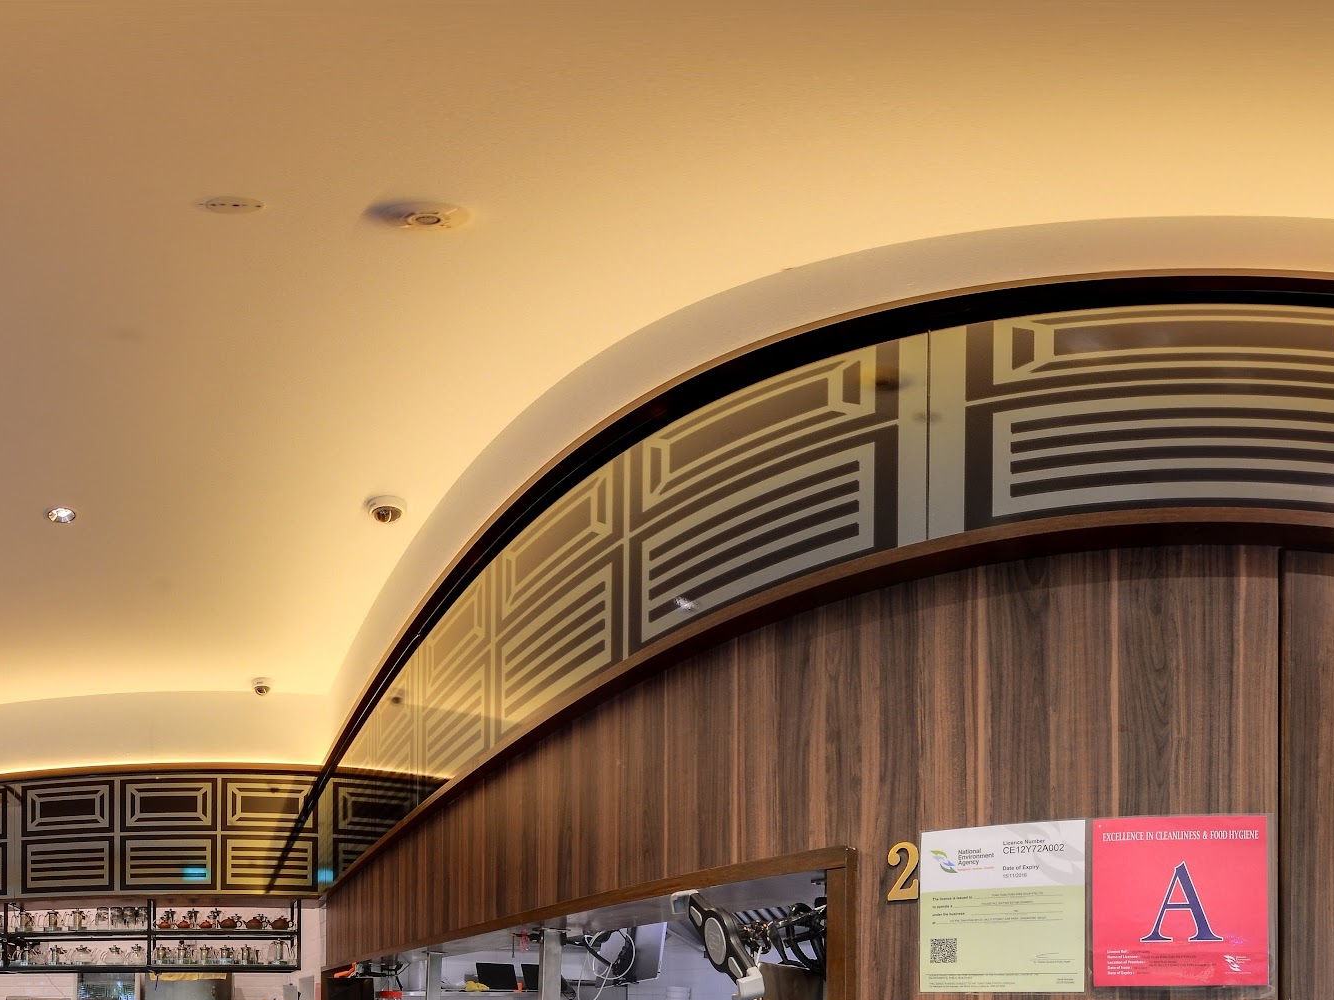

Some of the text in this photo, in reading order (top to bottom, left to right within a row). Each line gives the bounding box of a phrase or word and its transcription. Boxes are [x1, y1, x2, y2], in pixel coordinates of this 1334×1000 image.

[1102, 829, 1259, 842] EXCELLENCE IN CLEANLINESS & FOOD HYGIENE
[1002, 843, 1065, 855] CE12Y72A002
[957, 852, 995, 861] Environment
[957, 858, 980, 866] Agency
[887, 842, 919, 901] 2
[1140, 860, 1224, 942] A
